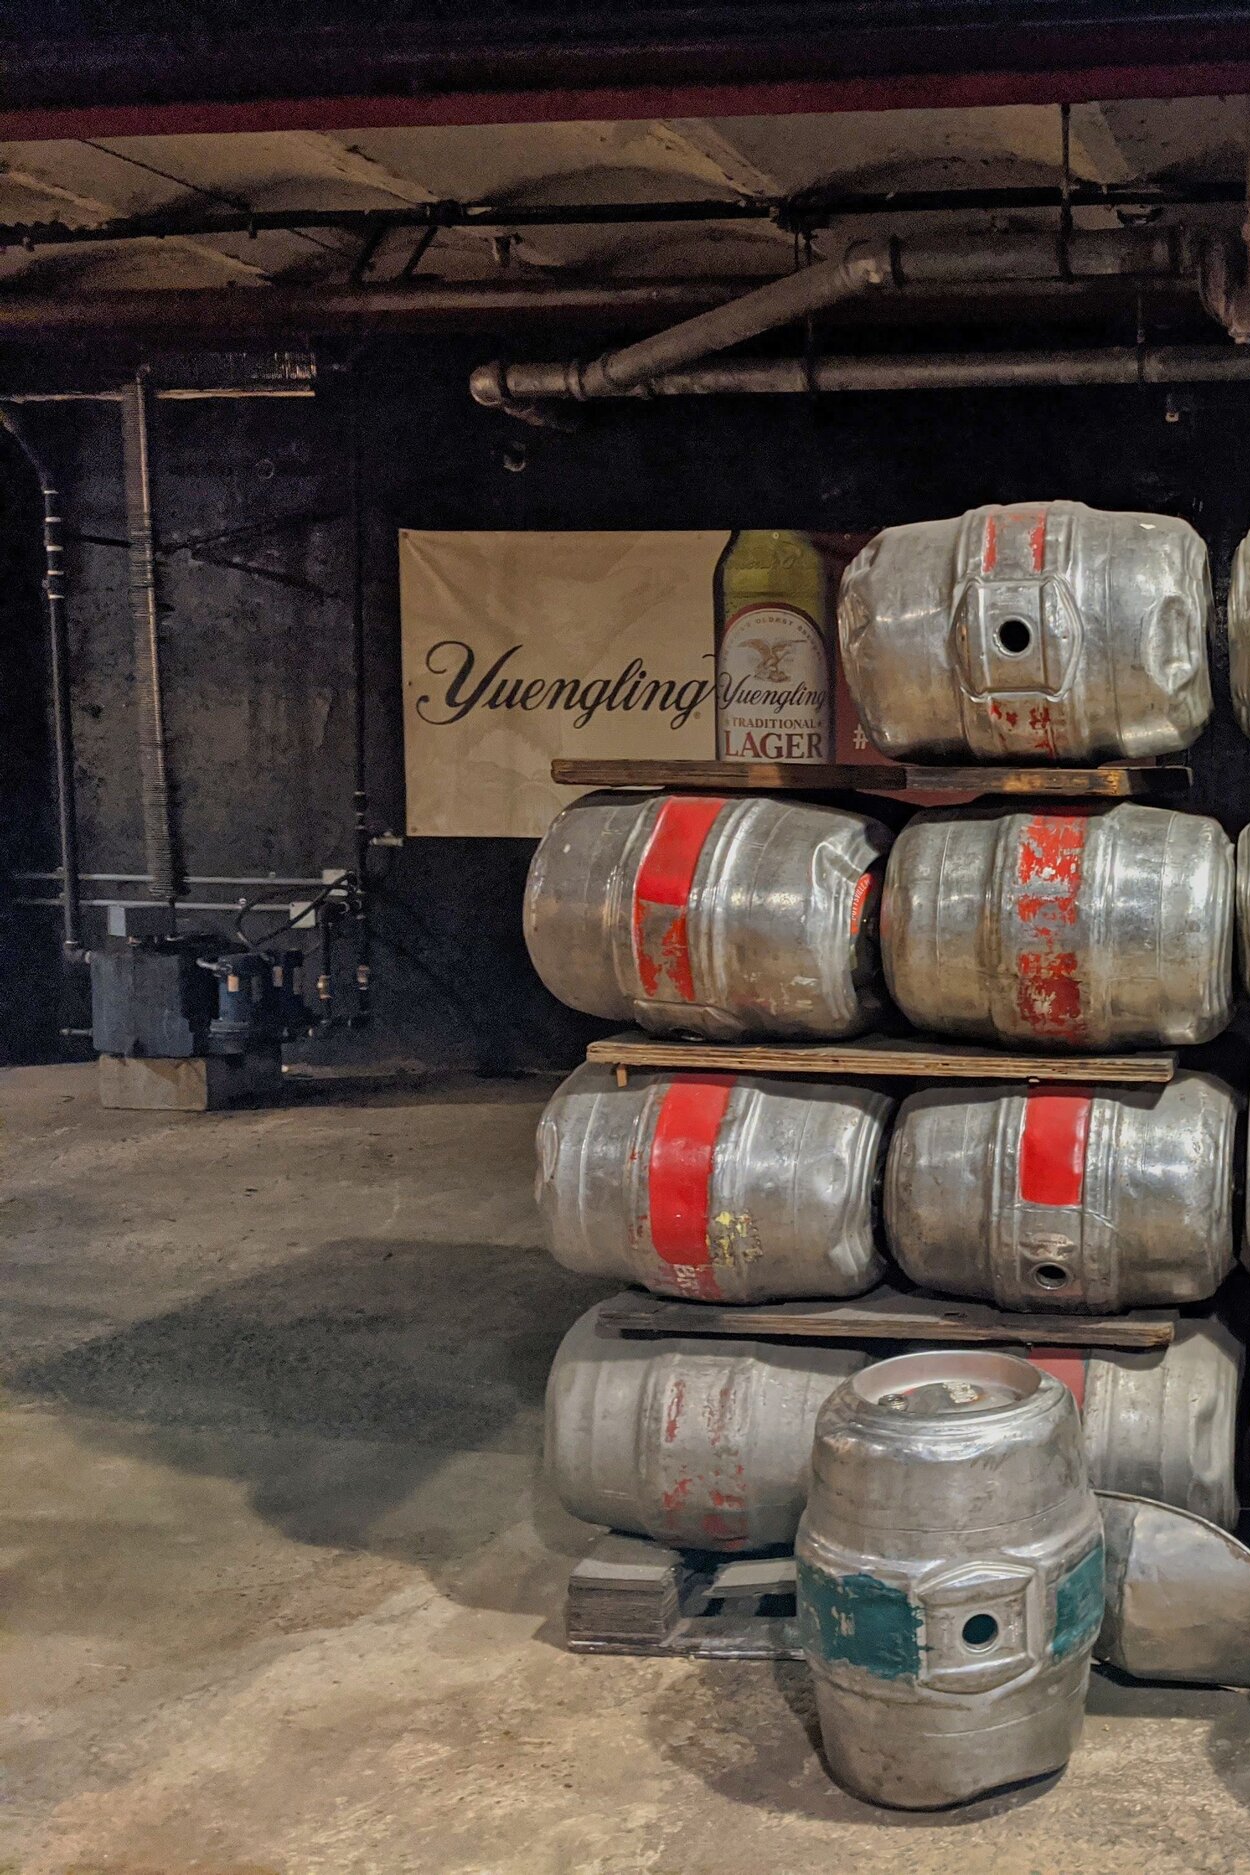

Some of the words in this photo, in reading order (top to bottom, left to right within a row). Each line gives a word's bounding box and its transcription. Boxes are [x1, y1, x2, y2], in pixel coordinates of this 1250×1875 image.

[416, 641, 716, 730] Yuengling
[717, 671, 827, 714] Yuengling
[732, 717, 816, 729] TRADITIONAL
[724, 730, 823, 759] LAGER
